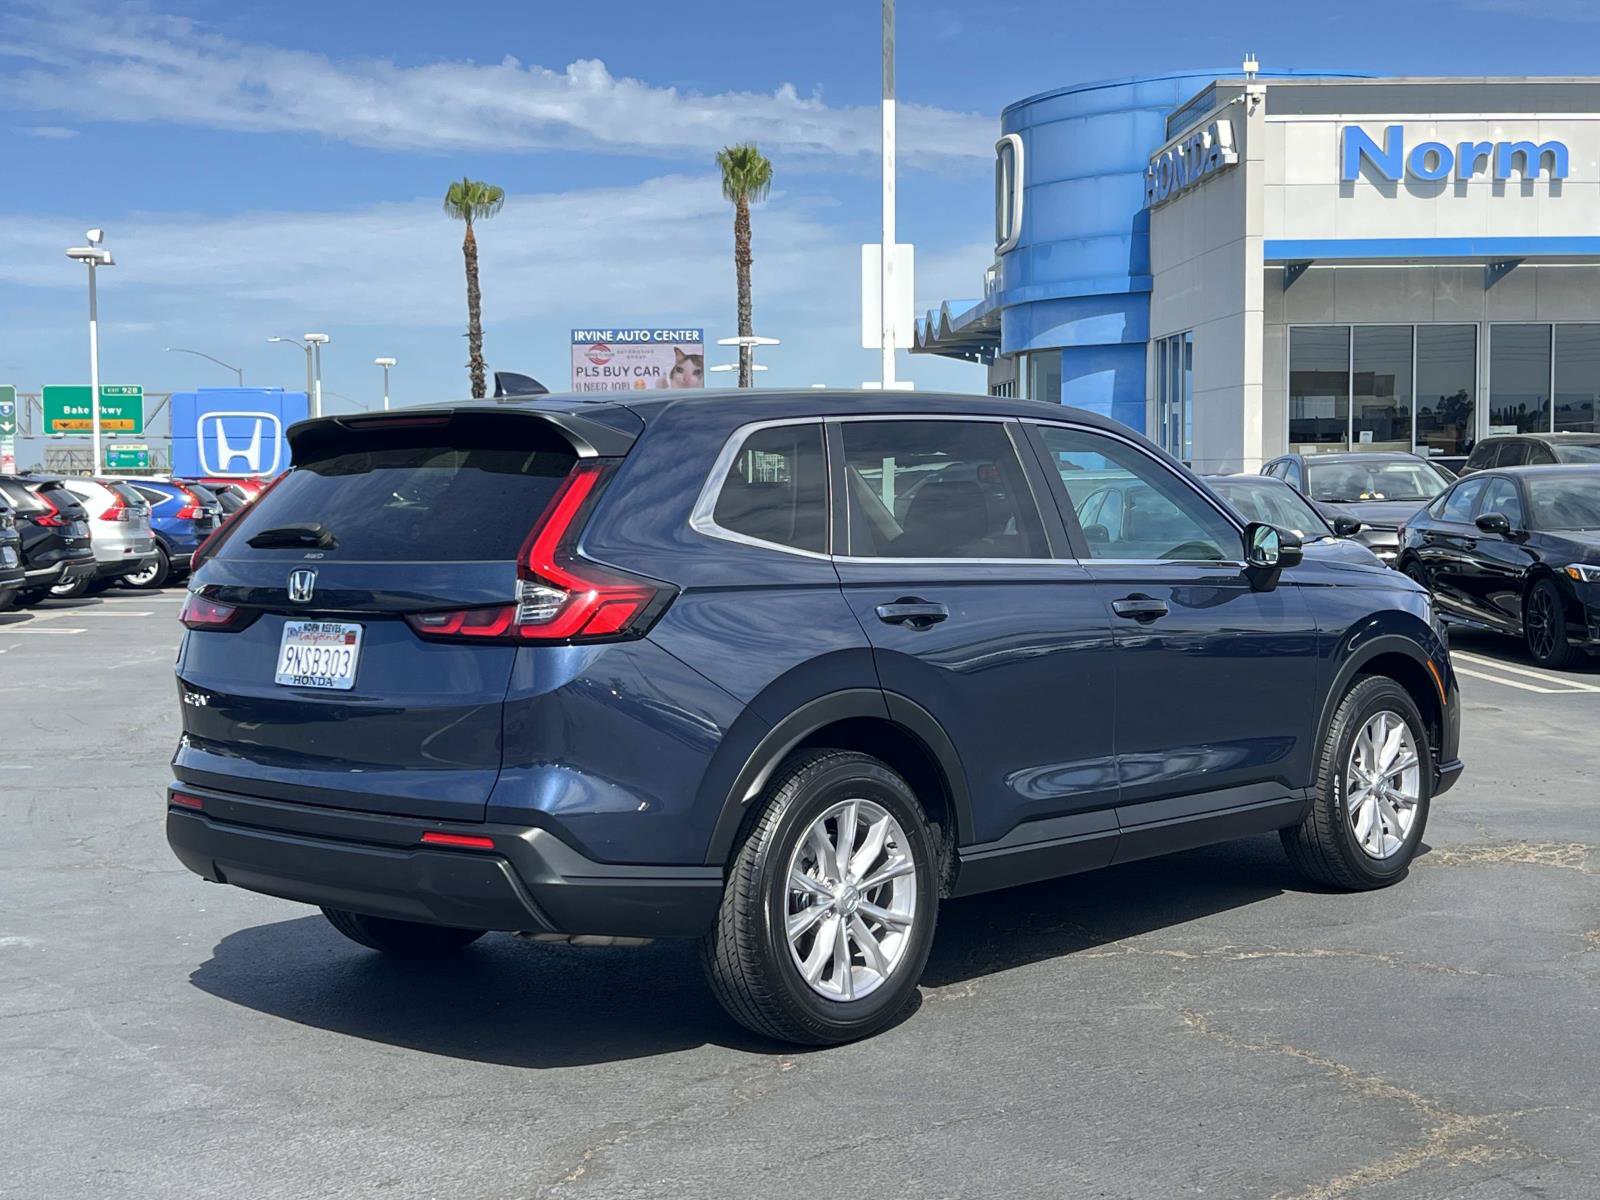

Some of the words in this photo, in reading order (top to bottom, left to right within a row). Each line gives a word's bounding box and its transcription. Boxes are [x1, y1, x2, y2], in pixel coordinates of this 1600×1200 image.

[1340, 125, 1569, 181] Norm
[1143, 120, 1238, 207] HONDA
[574, 331, 613, 341] IRVINE
[616, 331, 651, 341] AUTO
[653, 331, 700, 341] CENTER
[576, 366, 600, 377] PLS
[603, 366, 630, 377] BUY
[633, 366, 660, 377] CAR
[63, 405, 90, 415] Bake
[98, 406, 122, 416] kwy
[284, 646, 351, 678] 9NSB303
[293, 675, 334, 687] HONDA
